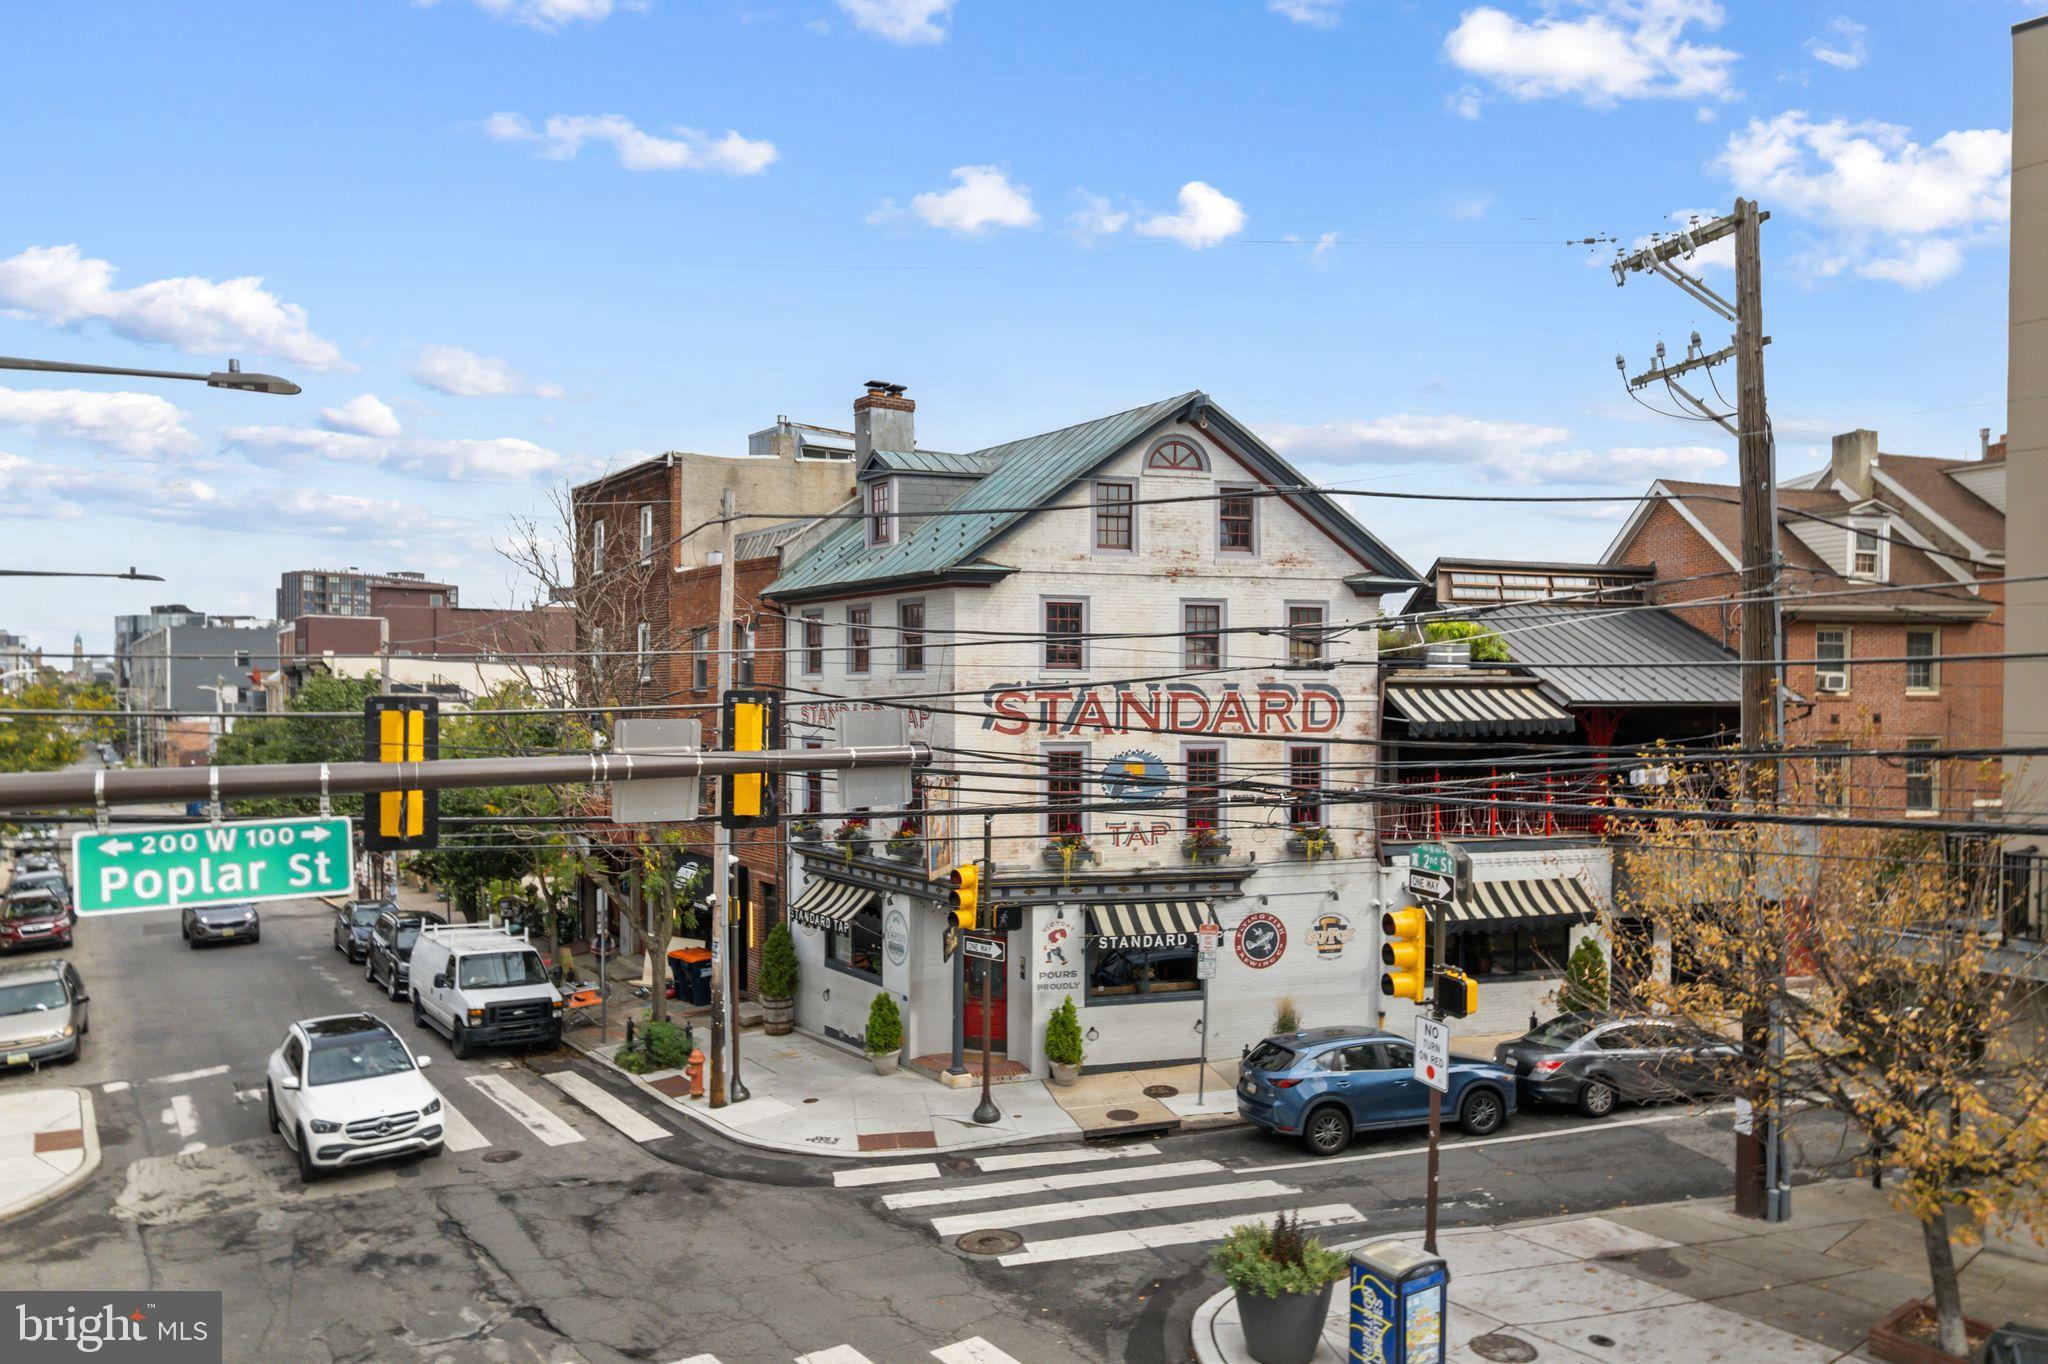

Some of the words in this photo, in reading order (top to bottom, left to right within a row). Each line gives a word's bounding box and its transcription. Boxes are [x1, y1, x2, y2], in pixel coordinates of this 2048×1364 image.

[982, 681, 1345, 736] STANDARD
[140, 833, 198, 855] 200
[204, 828, 239, 853] W
[246, 827, 295, 849] 100
[1105, 821, 1171, 848] TAP
[1423, 854, 1438, 869] 2nd
[1440, 857, 1453, 874] St
[100, 859, 267, 906] Poplar
[289, 851, 333, 888] St
[1412, 876, 1424, 888] ONE
[1426, 880, 1439, 891] WAY
[790, 907, 831, 929] STANDARD
[834, 919, 850, 933] TAP
[1236, 914, 1265, 938] FLYING
[1268, 914, 1285, 936] FISH
[1099, 933, 1188, 949] STANDARD
[1236, 945, 1276, 968] BREWING
[1039, 970, 1077, 979] POURS
[1036, 982, 1080, 991] PROUDLY
[1424, 1023, 1439, 1039] NO
[1422, 1038, 1441, 1053] TURN
[1418, 1050, 1428, 1062] ON
[1430, 1055, 1444, 1068] RED
